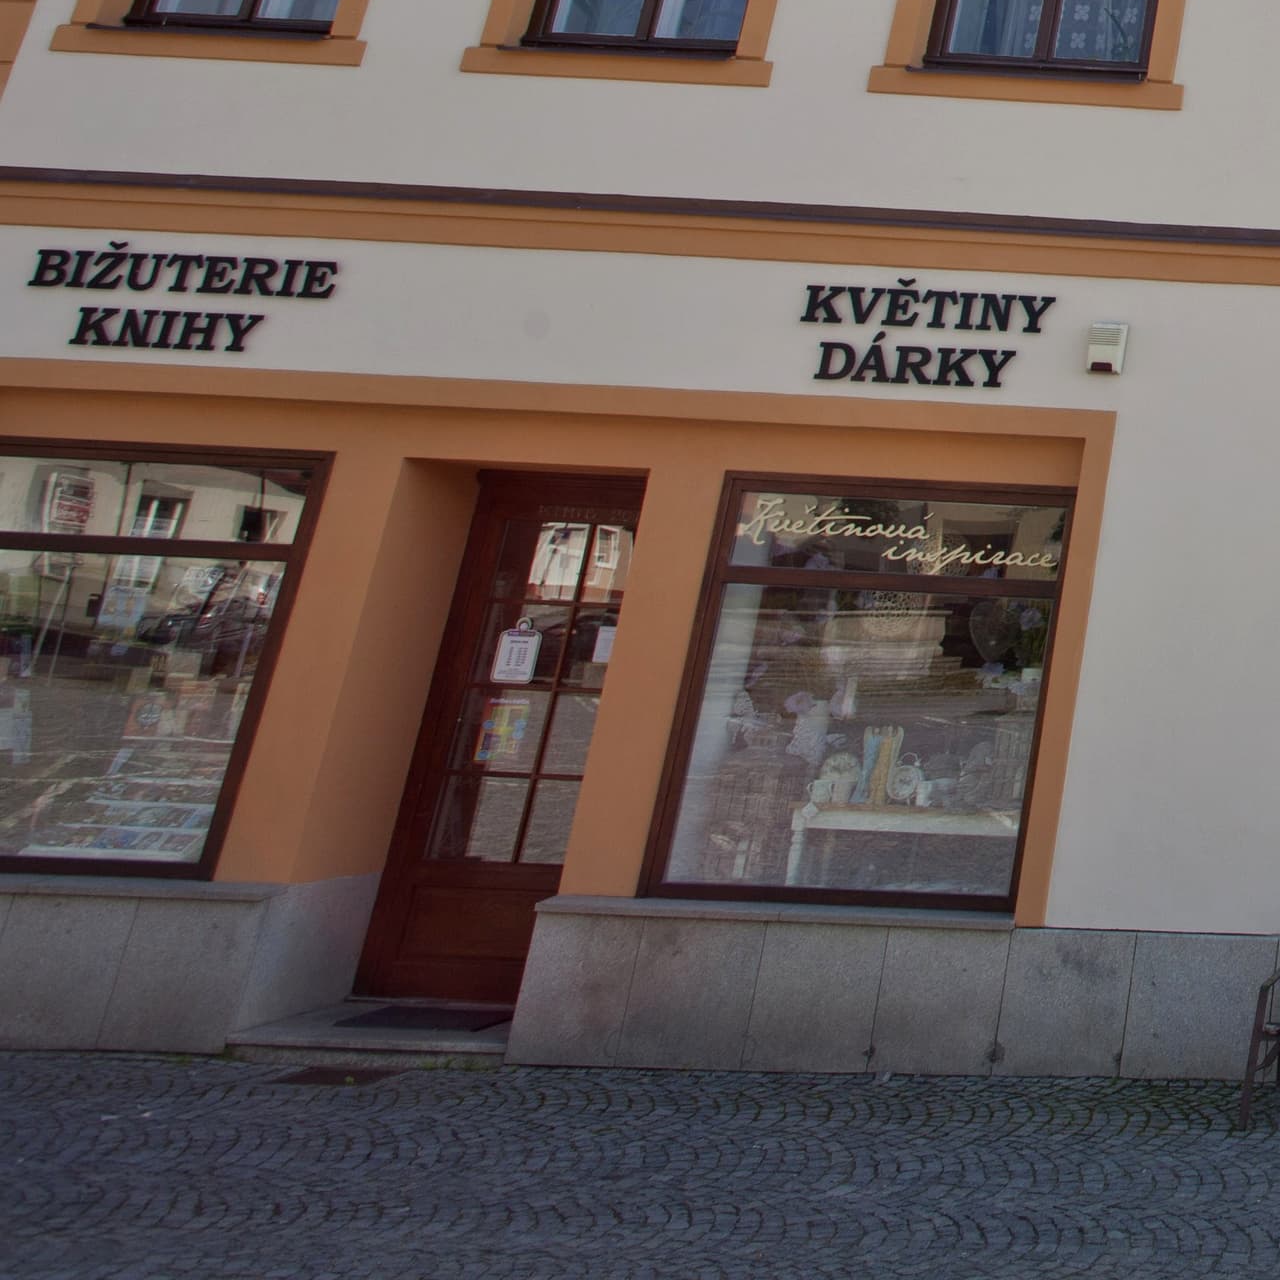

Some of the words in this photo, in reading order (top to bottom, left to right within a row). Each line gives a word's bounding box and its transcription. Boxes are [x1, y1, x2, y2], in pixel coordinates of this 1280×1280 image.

[27, 241, 339, 300] BIŽUTERIE
[68, 307, 265, 353] KNIHY
[800, 278, 1056, 334] KVĚTINY
[813, 331, 1016, 389] DÁRKY
[741, 498, 934, 545] Květinová
[882, 539, 1058, 575] inspirace
